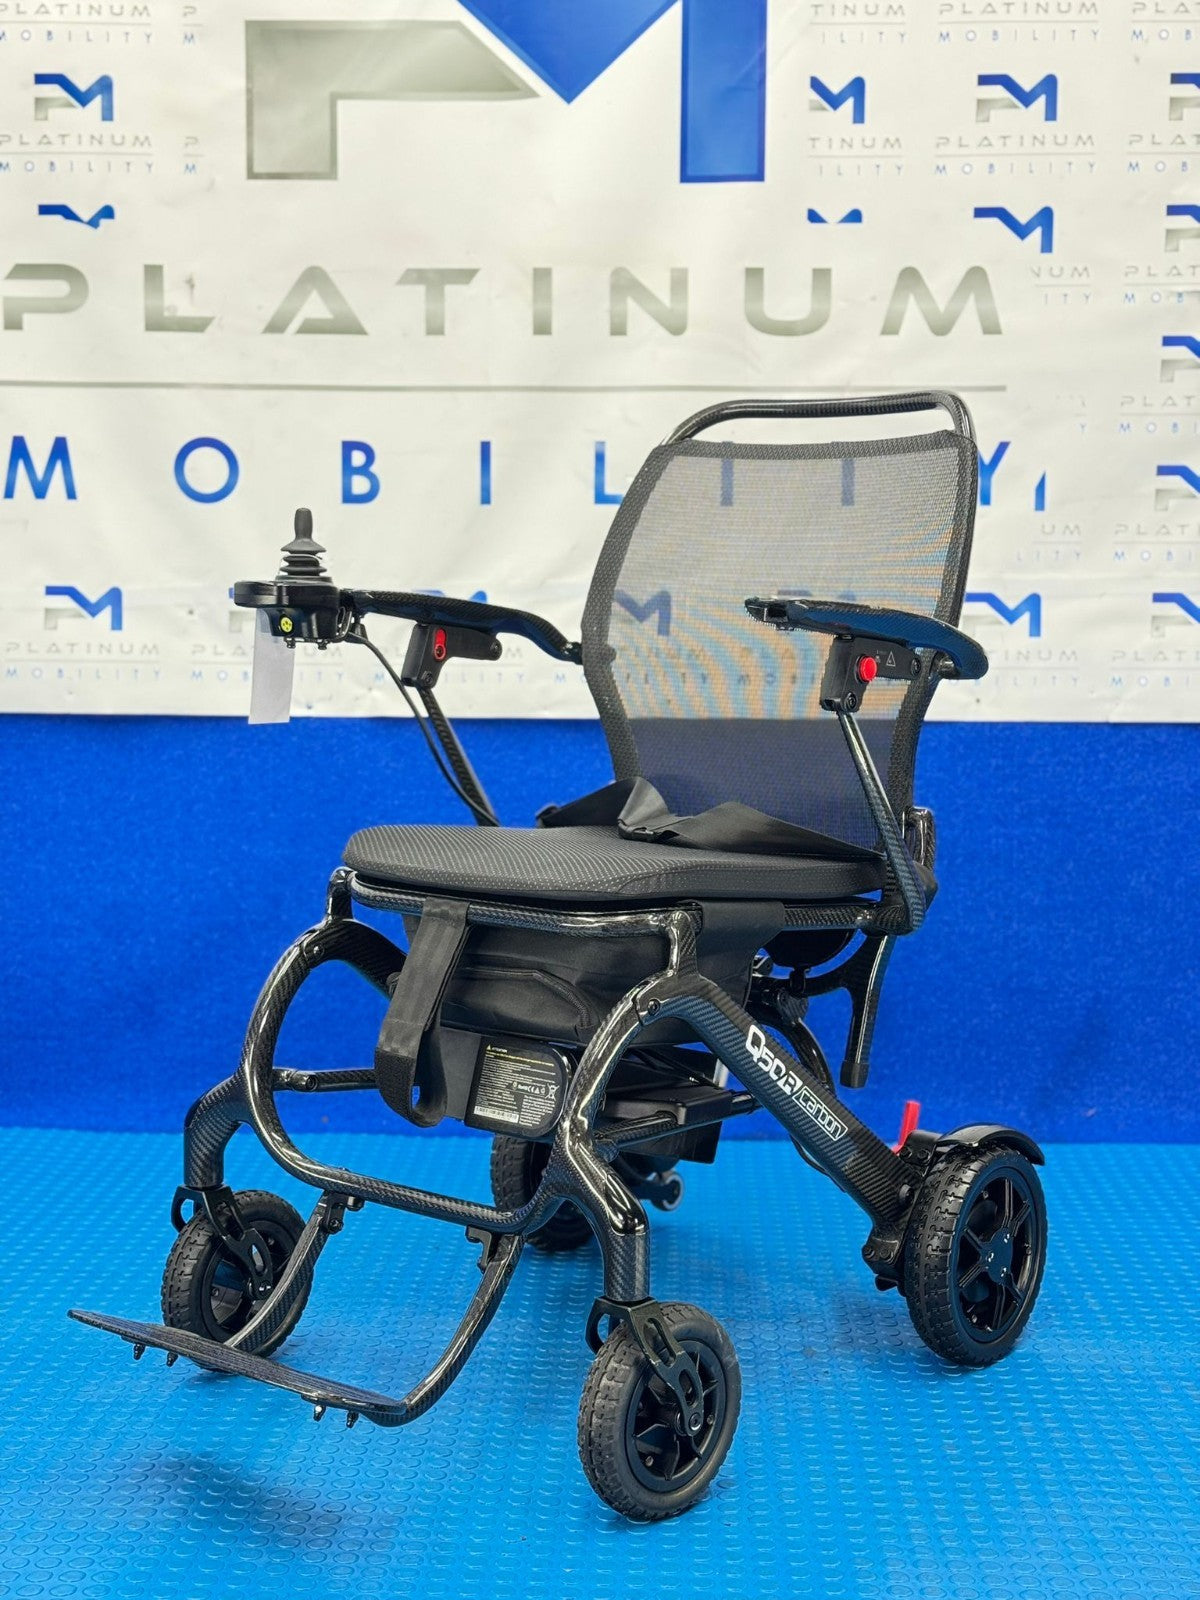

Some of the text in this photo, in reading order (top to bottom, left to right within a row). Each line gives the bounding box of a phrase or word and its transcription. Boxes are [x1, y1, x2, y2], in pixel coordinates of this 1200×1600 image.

[938, 1, 1098, 15] PLATINUM
[938, 29, 1099, 43] MOBILITY
[0, 134, 152, 147] PLATINUM
[935, 134, 1095, 147] PLATINUM
[0, 161, 153, 172] MOBILITY
[935, 162, 1096, 174] MOBILITY
[4, 263, 1003, 336] PLATINUM
[5, 642, 161, 656] PLATINUM
[6, 668, 162, 681] MOBILITY
[745, 1024, 803, 1096] Q50R
